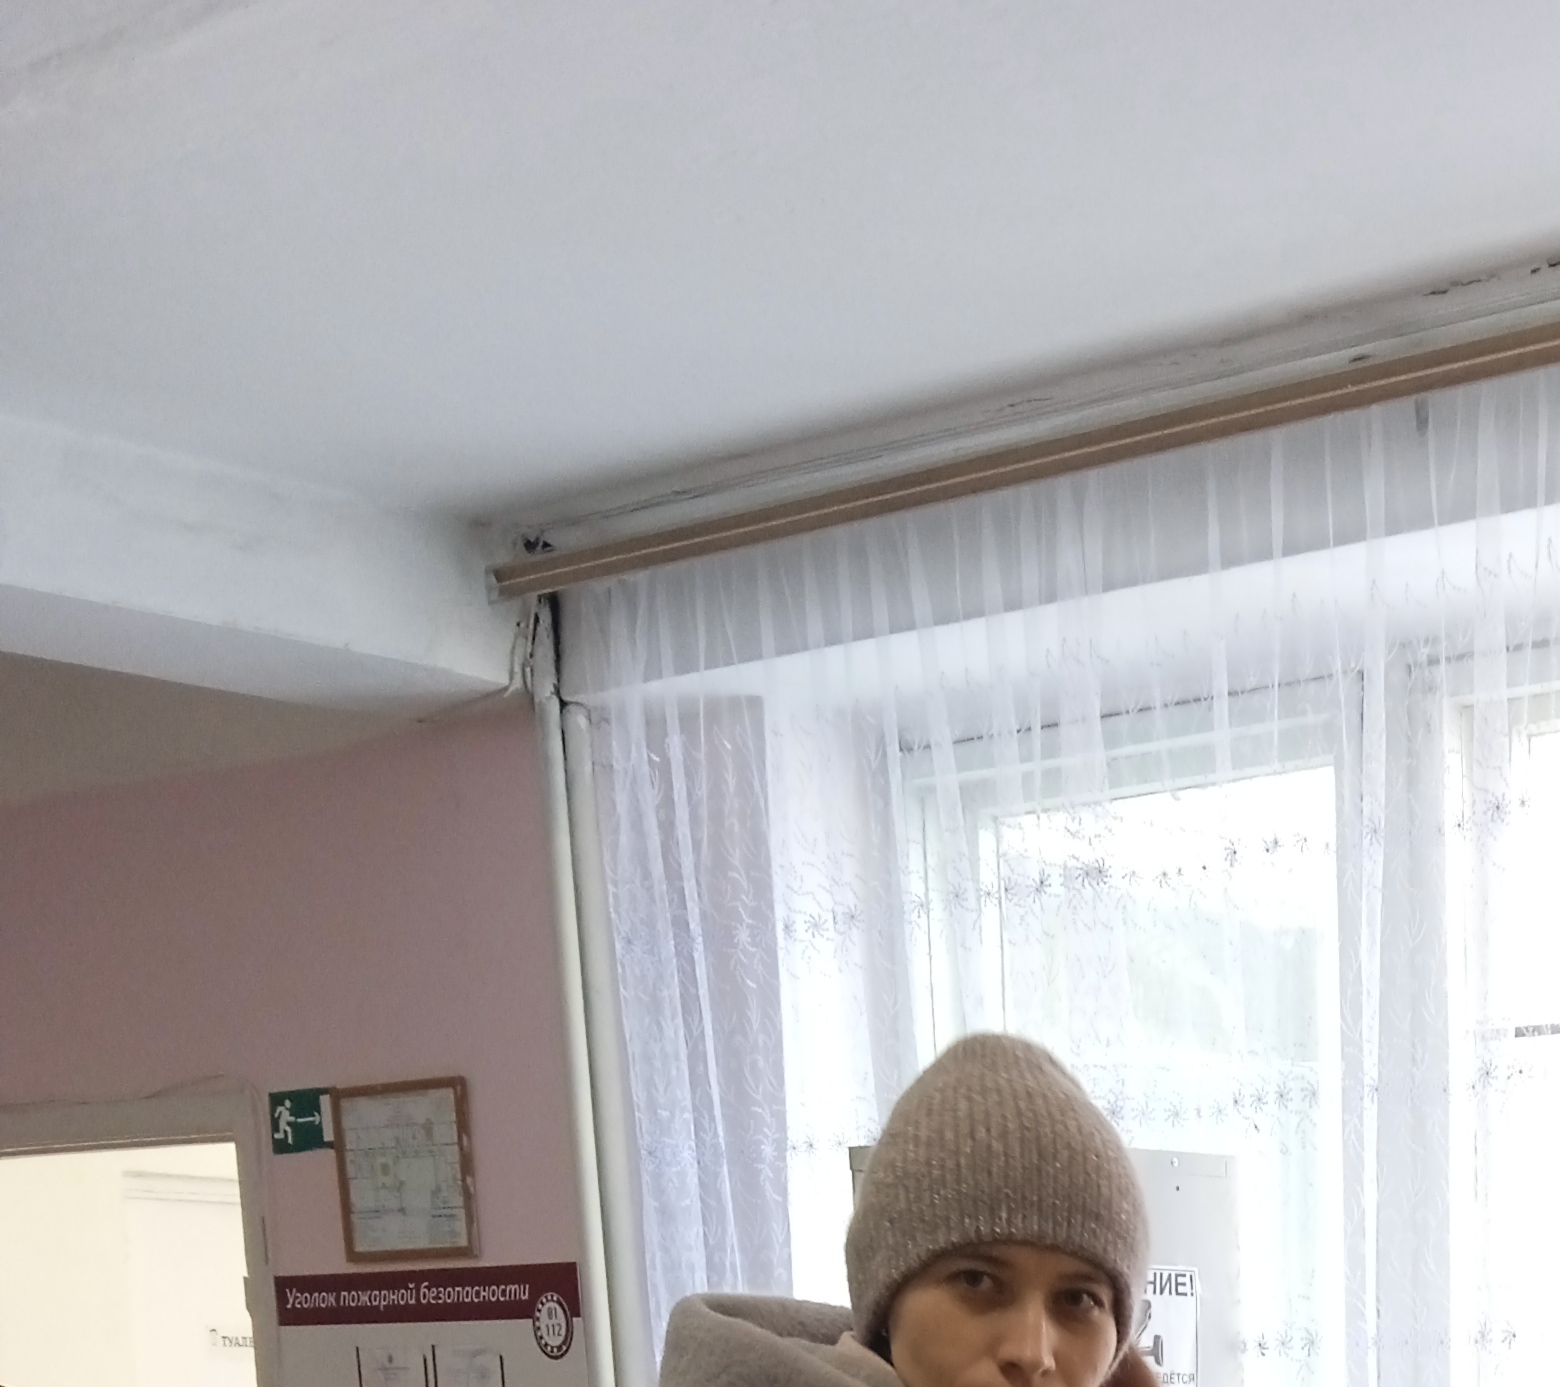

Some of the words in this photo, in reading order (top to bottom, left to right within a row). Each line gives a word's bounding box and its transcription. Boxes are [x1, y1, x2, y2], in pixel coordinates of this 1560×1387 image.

[286, 1287, 337, 1308] Уголок
[339, 1283, 416, 1311] пожарной
[420, 1281, 530, 1302] безопасности
[545, 1322, 563, 1337] 112
